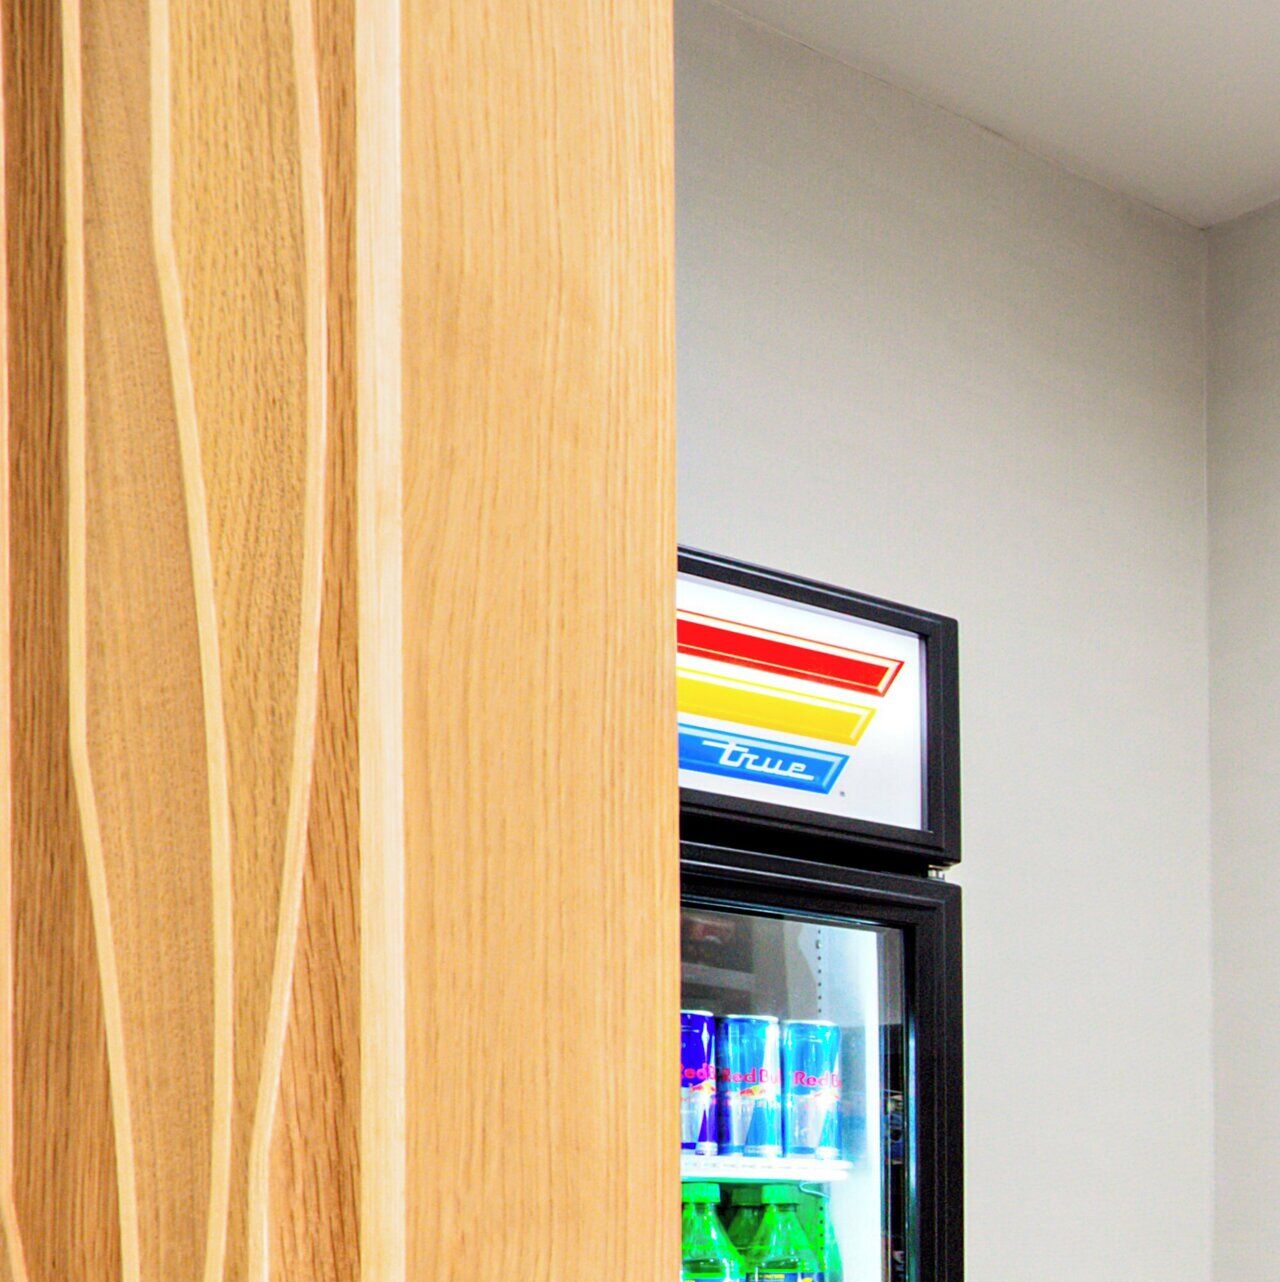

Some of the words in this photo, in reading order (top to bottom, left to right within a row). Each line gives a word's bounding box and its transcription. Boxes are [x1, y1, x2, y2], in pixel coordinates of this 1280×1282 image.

[702, 740, 814, 781] true
[719, 1068, 756, 1083] Red
[794, 1070, 829, 1087] Red
